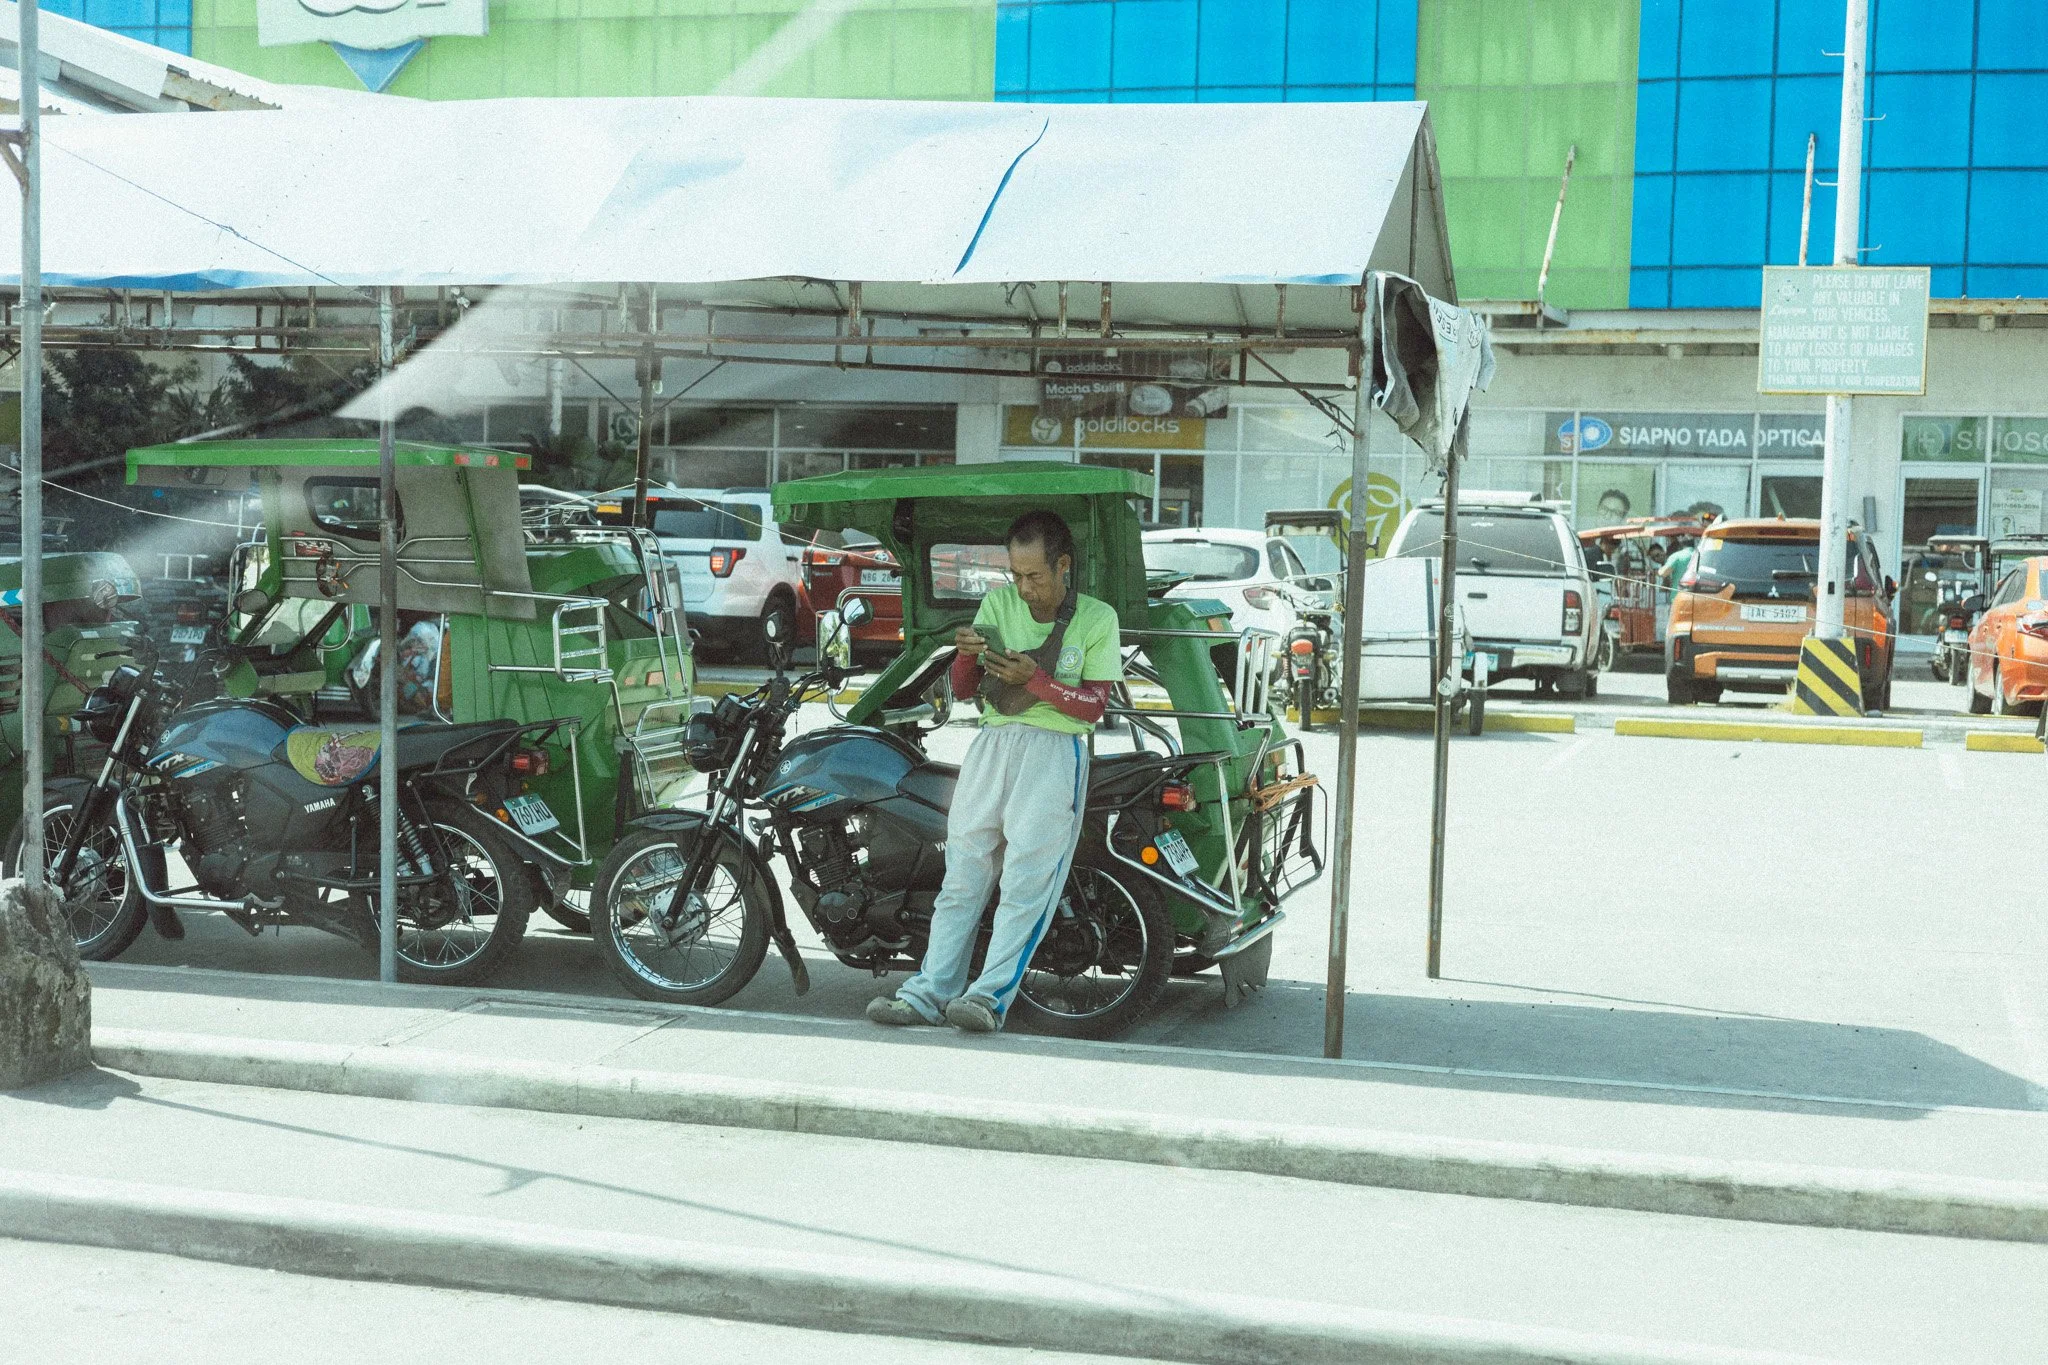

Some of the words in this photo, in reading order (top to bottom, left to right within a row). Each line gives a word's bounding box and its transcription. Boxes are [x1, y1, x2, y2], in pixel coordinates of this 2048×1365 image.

[1812, 274, 1849, 289] PLEASE
[1854, 274, 1868, 289] DO
[1871, 275, 1890, 289] NOT
[1893, 275, 1924, 290] LEAVE
[1812, 291, 1832, 305] ANY
[1836, 291, 1886, 305] VALUABLE
[1889, 292, 1900, 306] IN
[1812, 307, 1838, 322] YOUR
[1767, 325, 1833, 339] MANAGEMENT
[1838, 325, 1847, 339] IS
[1852, 326, 1871, 340] NOT
[1768, 342, 1781, 356] TO
[1784, 342, 1806, 356] ANY
[1809, 342, 1846, 357] LOSSES
[1849, 343, 1863, 357] OR
[1866, 343, 1915, 357] DAMAGES
[1767, 358, 1781, 372] TO
[1784, 358, 1810, 373] YOUR
[1767, 374, 1797, 385] THANK
[1801, 375, 1817, 385] YOU
[1820, 375, 1836, 385] FOR
[1840, 375, 1862, 386] YOUR
[1045, 382, 1091, 395] Mocha
[1619, 426, 1691, 446] SIAPNO
[1697, 427, 1747, 447] TADA
[304, 797, 336, 813] YAMAHA
